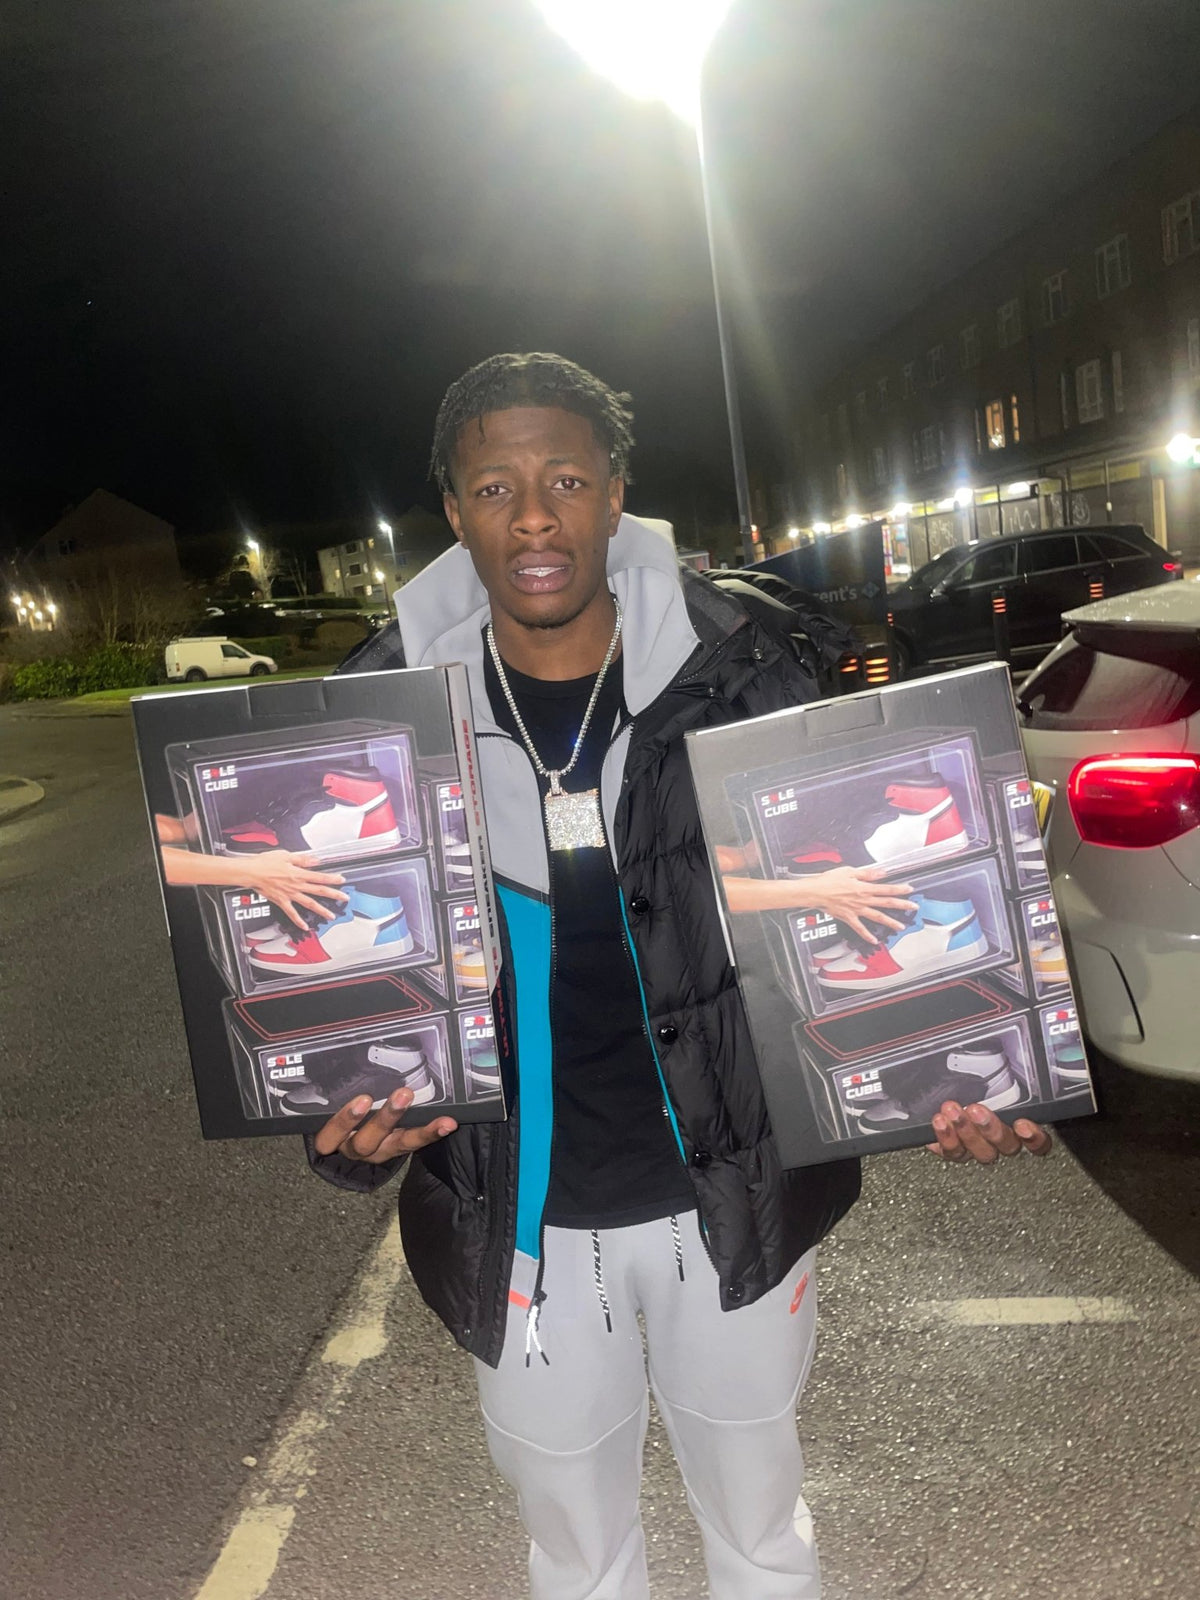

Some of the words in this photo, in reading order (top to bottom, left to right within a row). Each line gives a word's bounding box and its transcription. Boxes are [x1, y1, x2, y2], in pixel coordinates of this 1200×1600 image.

[202, 765, 236, 780] SOLE
[462, 719, 480, 826] STORAGE
[205, 778, 238, 792] CUBE
[761, 788, 795, 806] SOLE
[764, 800, 798, 818] CUBE
[478, 835, 495, 938] SNEAKER
[234, 905, 271, 921] CUBE
[800, 924, 838, 942] CUBE
[267, 1053, 303, 1068] SOLE
[270, 1065, 305, 1080] CUBE
[842, 1070, 880, 1088] SOLE
[845, 1081, 883, 1100] CUBE
